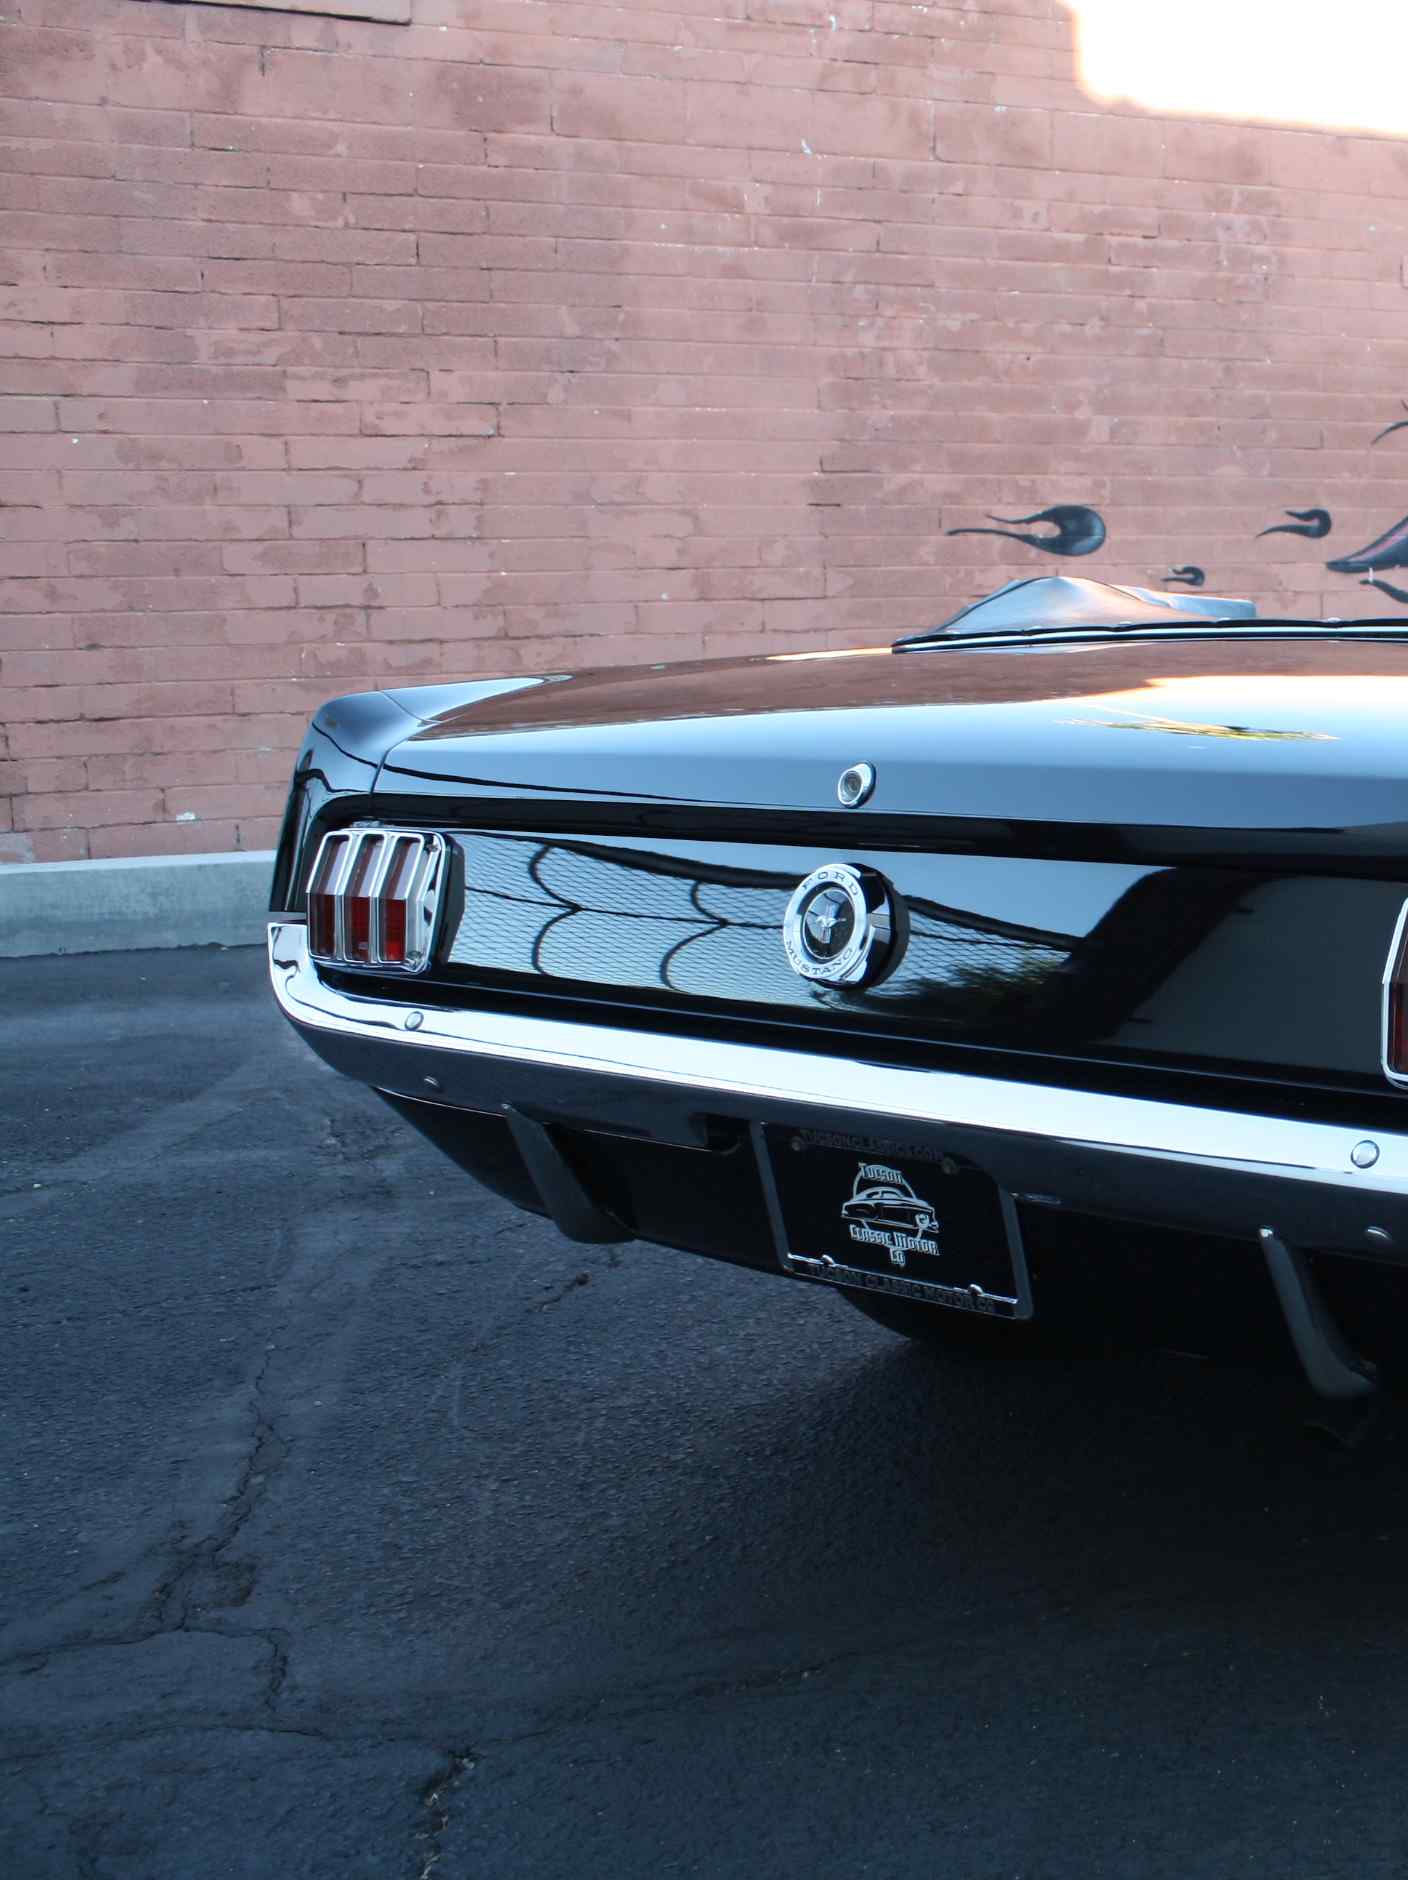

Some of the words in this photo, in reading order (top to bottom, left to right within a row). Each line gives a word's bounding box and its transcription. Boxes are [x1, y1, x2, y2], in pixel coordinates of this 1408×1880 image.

[801, 871, 859, 896] FORD
[785, 940, 853, 976] MUSTANG
[858, 1162, 903, 1185] TUCSON
[849, 1224, 892, 1247] CLASSIC
[893, 1231, 940, 1256] MOTOR
